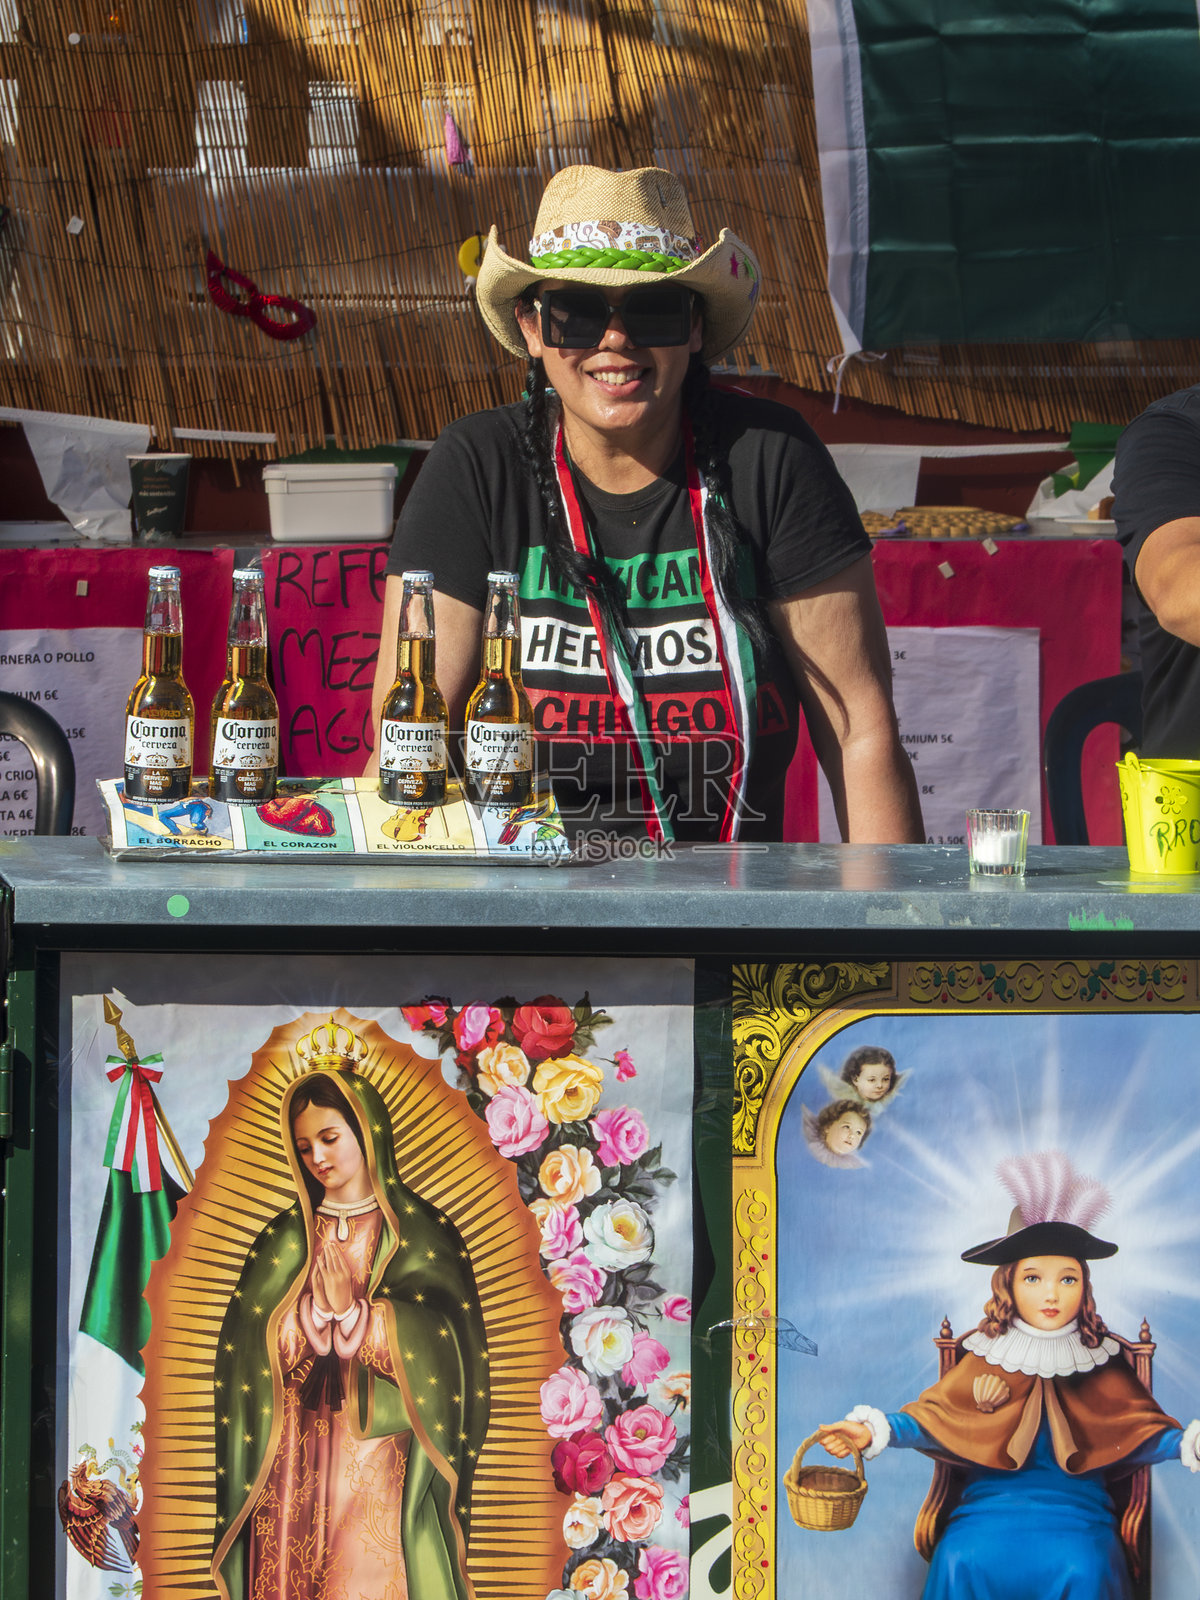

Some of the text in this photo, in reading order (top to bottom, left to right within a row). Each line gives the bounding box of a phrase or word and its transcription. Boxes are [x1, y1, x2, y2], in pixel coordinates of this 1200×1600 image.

[527, 624, 720, 671] HERMOS
[44, 652, 53, 663] O
[56, 652, 95, 663] POLLO
[894, 651, 907, 660] 3€
[44, 690, 59, 700] 6€
[66, 728, 86, 739] 15€
[130, 719, 186, 740] Corona
[222, 721, 276, 742] Corona
[385, 723, 440, 743] Corona
[471, 724, 527, 744] Corona
[941, 734, 954, 744] 5€
[141, 741, 177, 750] cerveza
[236, 742, 270, 750] cerveza
[396, 744, 433, 752] cerveza
[482, 745, 519, 753] cerveza
[922, 785, 935, 794] 8€
[14, 790, 29, 800] 6€
[19, 809, 33, 820] 4€
[157, 838, 222, 847] BORRACHO
